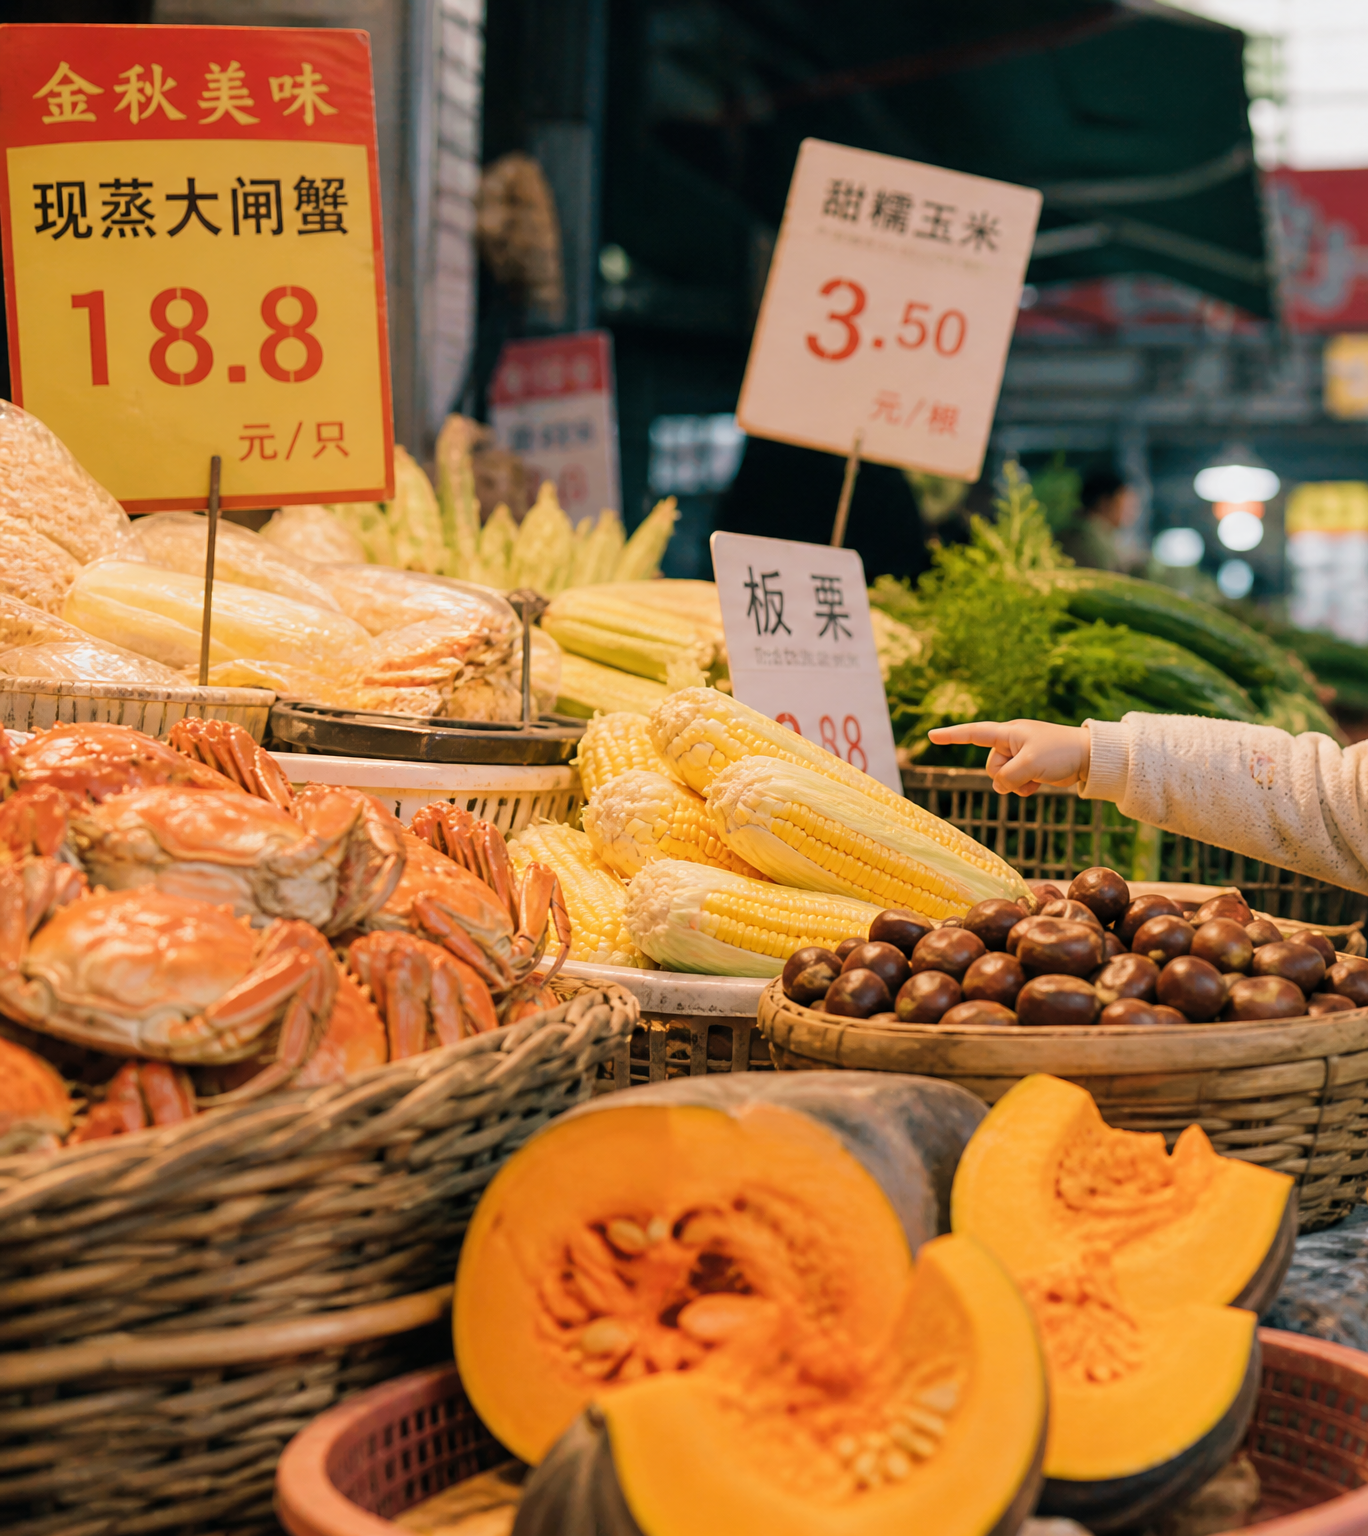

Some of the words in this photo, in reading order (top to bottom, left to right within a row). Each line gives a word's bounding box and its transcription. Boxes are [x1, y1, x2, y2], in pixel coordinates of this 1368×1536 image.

[33, 60, 338, 126] 金秋美味
[33, 175, 349, 241] 现蒸大闸蟹
[821, 177, 1002, 254] 甜糯玉米
[70, 285, 324, 387] 18.8
[805, 276, 968, 363] 3.50
[239, 420, 350, 461] 元/只
[744, 565, 853, 641] 板栗
